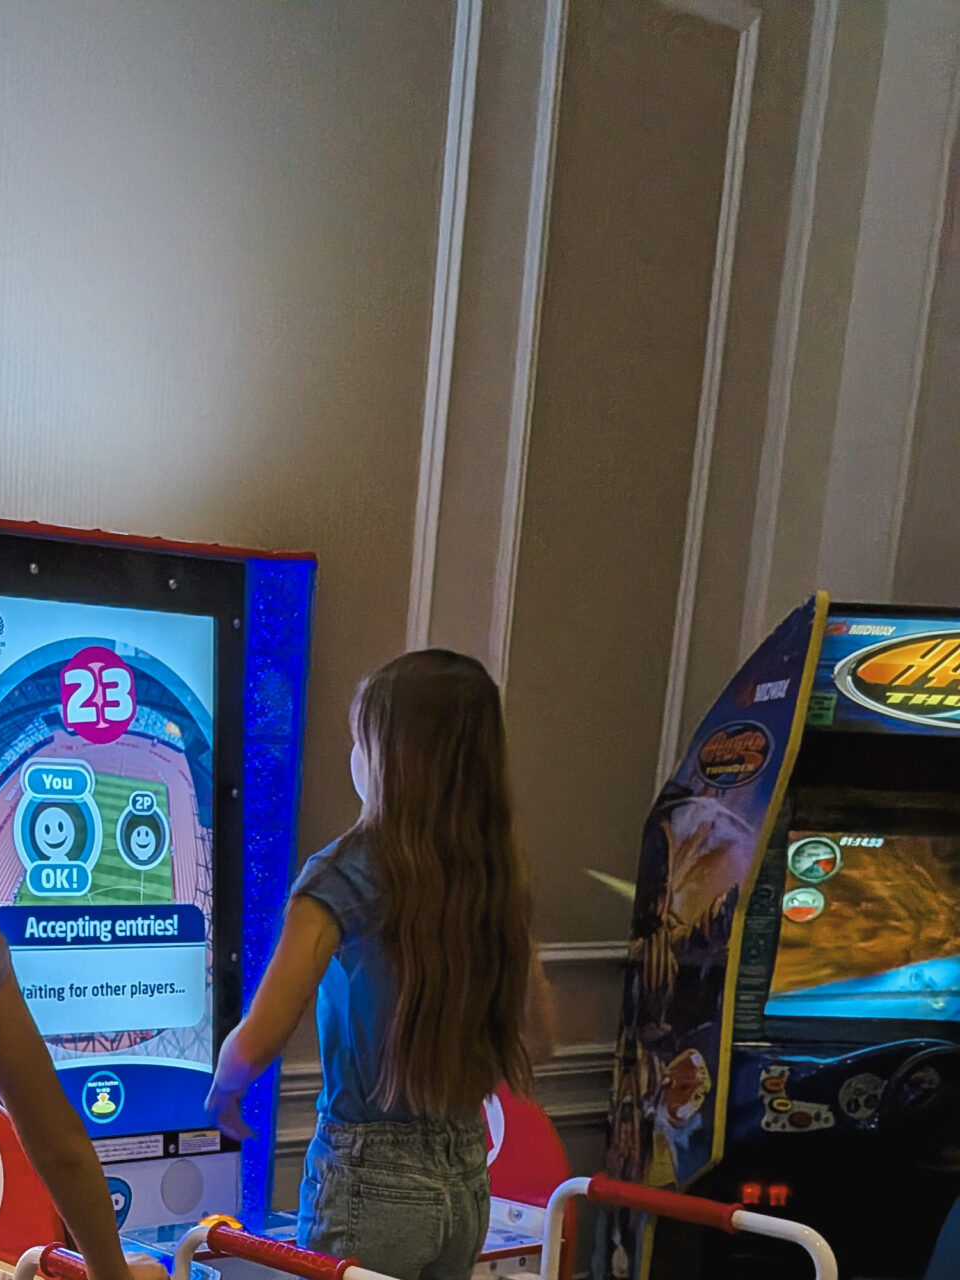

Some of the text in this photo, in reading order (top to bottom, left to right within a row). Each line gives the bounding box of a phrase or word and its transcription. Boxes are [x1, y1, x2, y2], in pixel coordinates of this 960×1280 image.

[848, 625, 896, 635] MIDWAY
[64, 667, 133, 724] 23
[42, 774, 73, 790] You
[135, 797, 152, 810] 2P
[41, 868, 78, 889] OK!
[25, 914, 178, 942] Accepting entries!
[69, 983, 88, 998] for
[91, 982, 126, 997] other
[129, 981, 185, 999] players...
